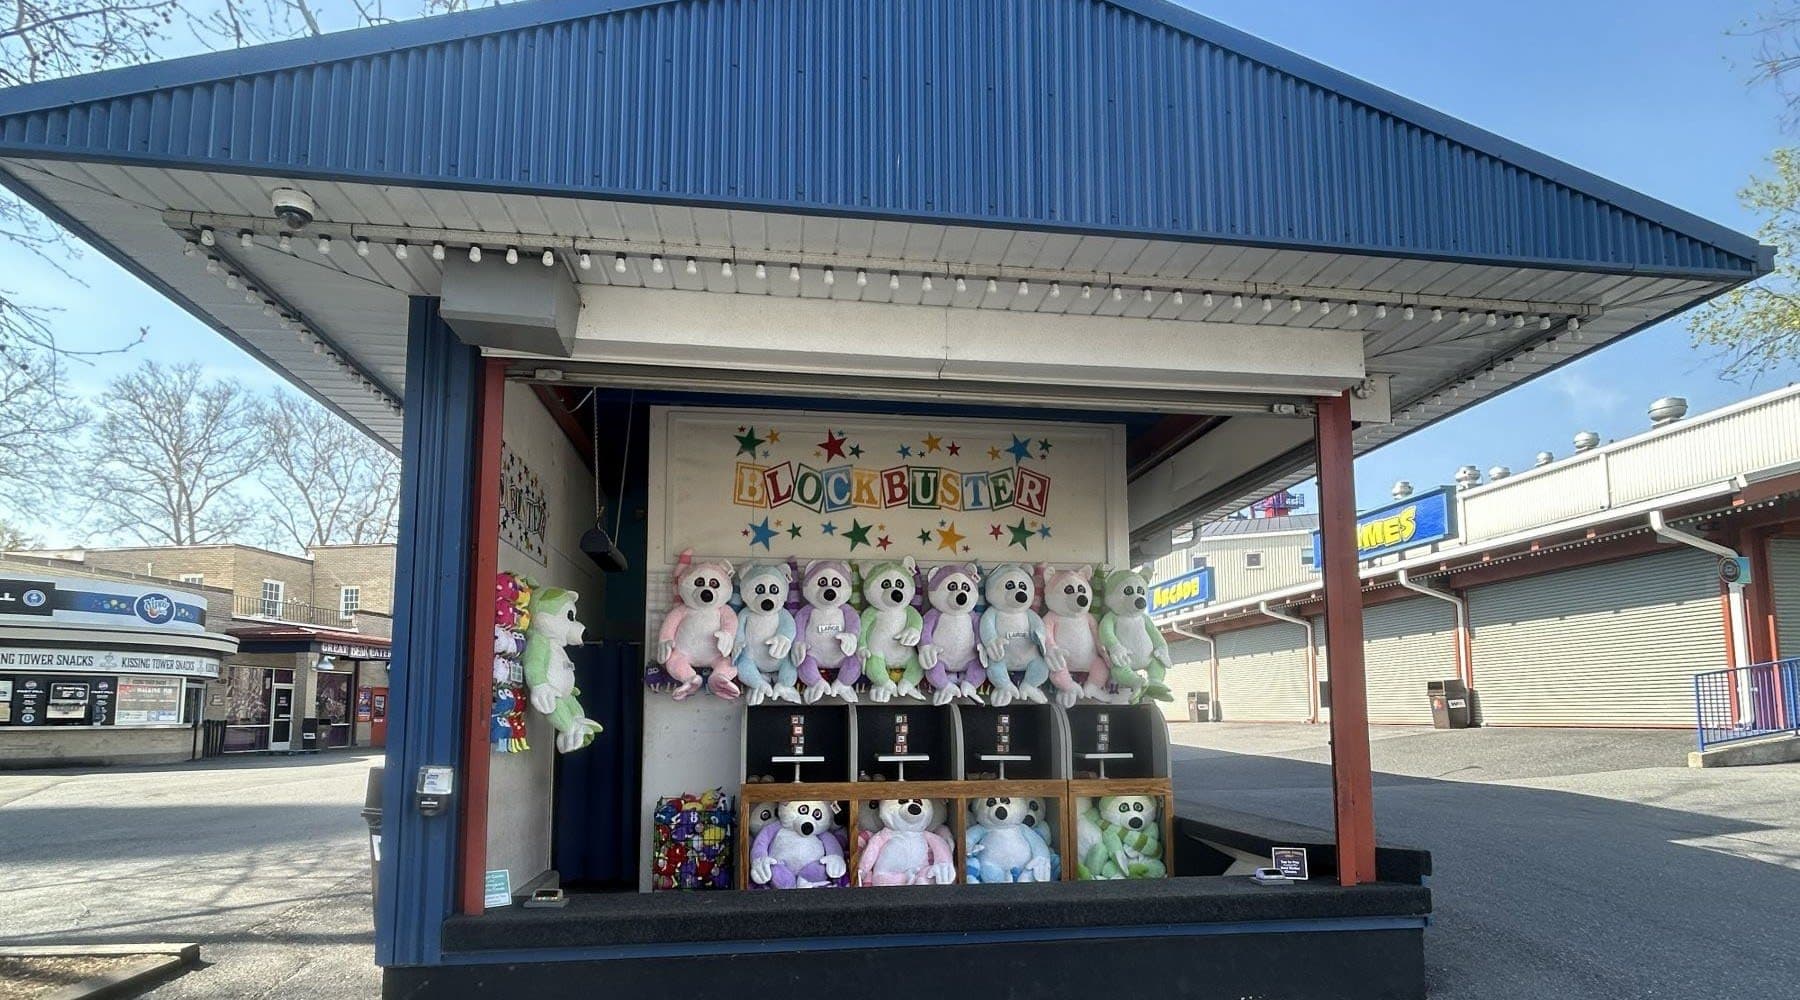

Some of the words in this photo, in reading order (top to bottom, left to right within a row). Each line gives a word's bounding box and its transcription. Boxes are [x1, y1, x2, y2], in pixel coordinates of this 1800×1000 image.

[735, 465, 1048, 513] BLOCKBUSTER
[1357, 505, 1416, 550] MES
[1153, 576, 1200, 609] ARCADE
[18, 653, 54, 665] TOWER
[56, 654, 94, 666] SNACKS
[121, 657, 150, 668] KISSING
[152, 658, 174, 669] TOWER
[175, 659, 195, 670] SNACKS
